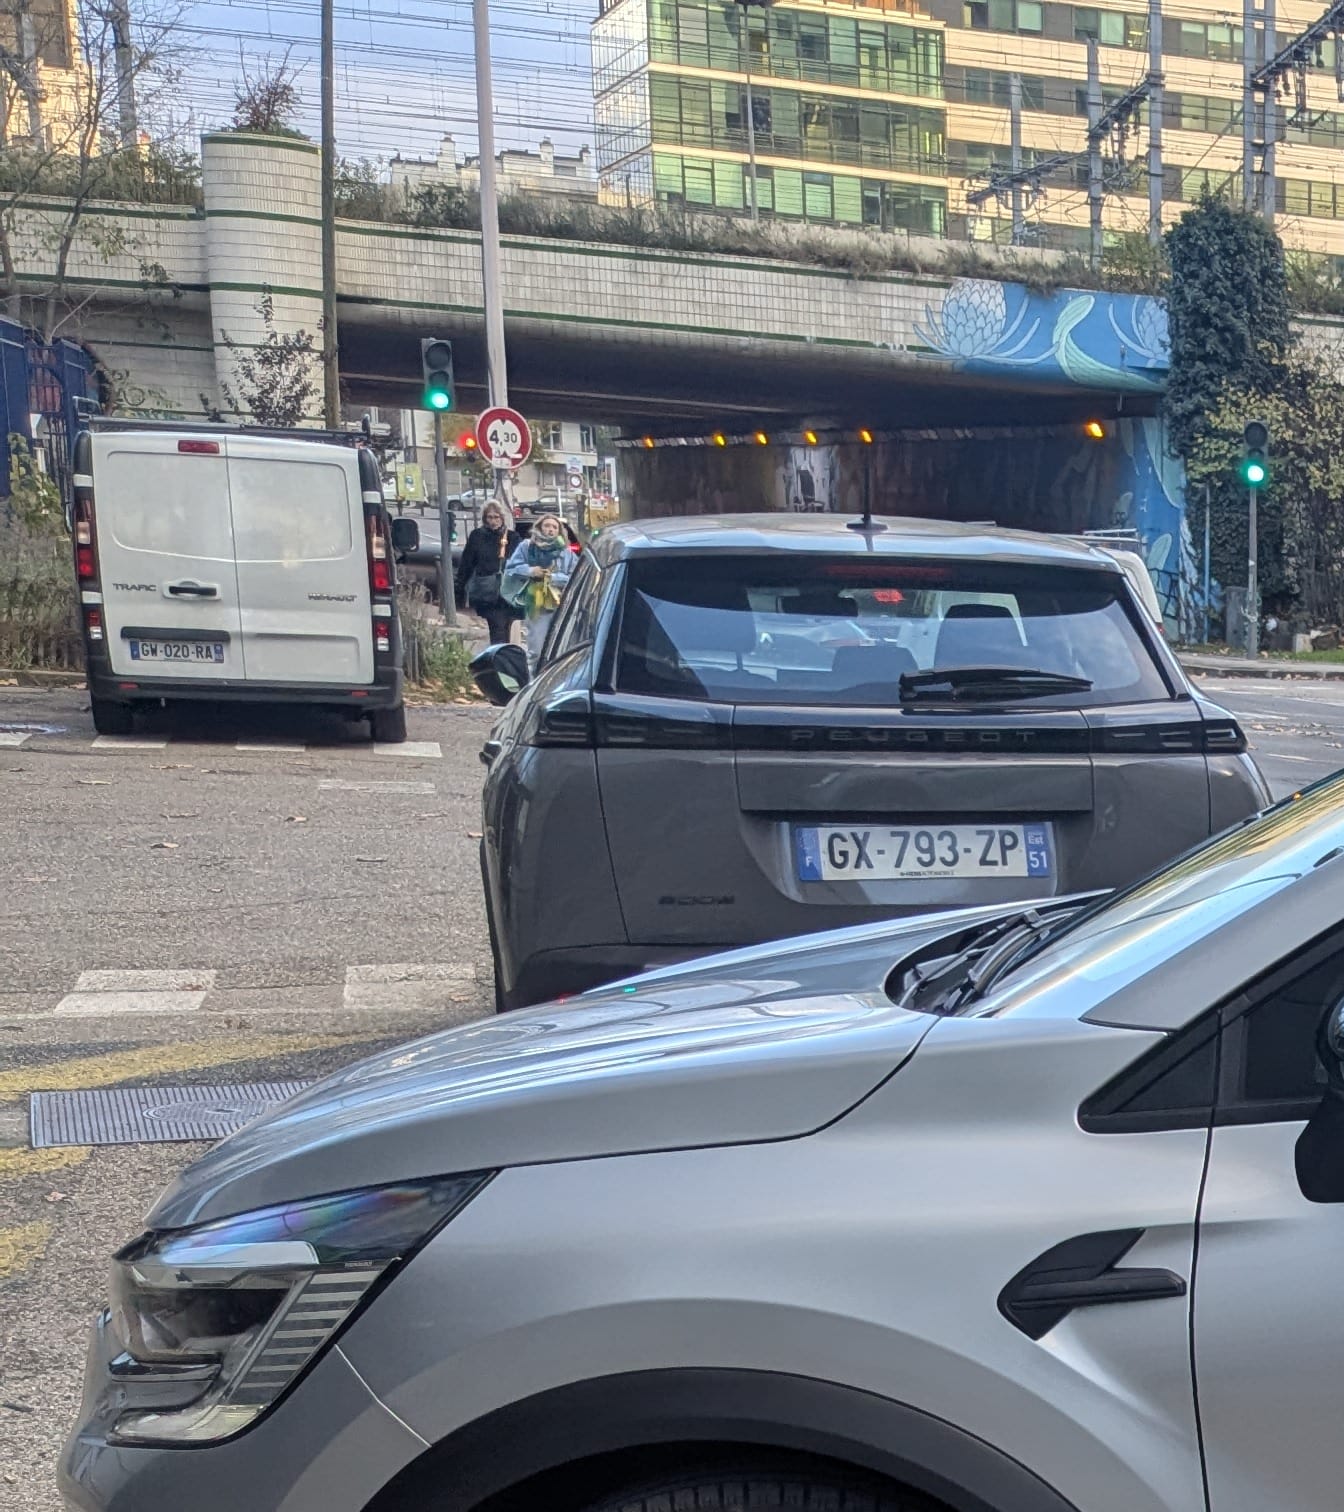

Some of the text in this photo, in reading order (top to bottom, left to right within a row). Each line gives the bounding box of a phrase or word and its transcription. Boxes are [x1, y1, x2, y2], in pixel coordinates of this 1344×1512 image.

[489, 429, 518, 446] 4,30
[113, 583, 156, 592] TRAFIC
[141, 642, 213, 660] GW-020-RA
[791, 729, 1036, 743] PEUGEOT
[827, 829, 1019, 870] GX-793-ZP
[805, 856, 813, 867] F
[1029, 851, 1047, 869] 51
